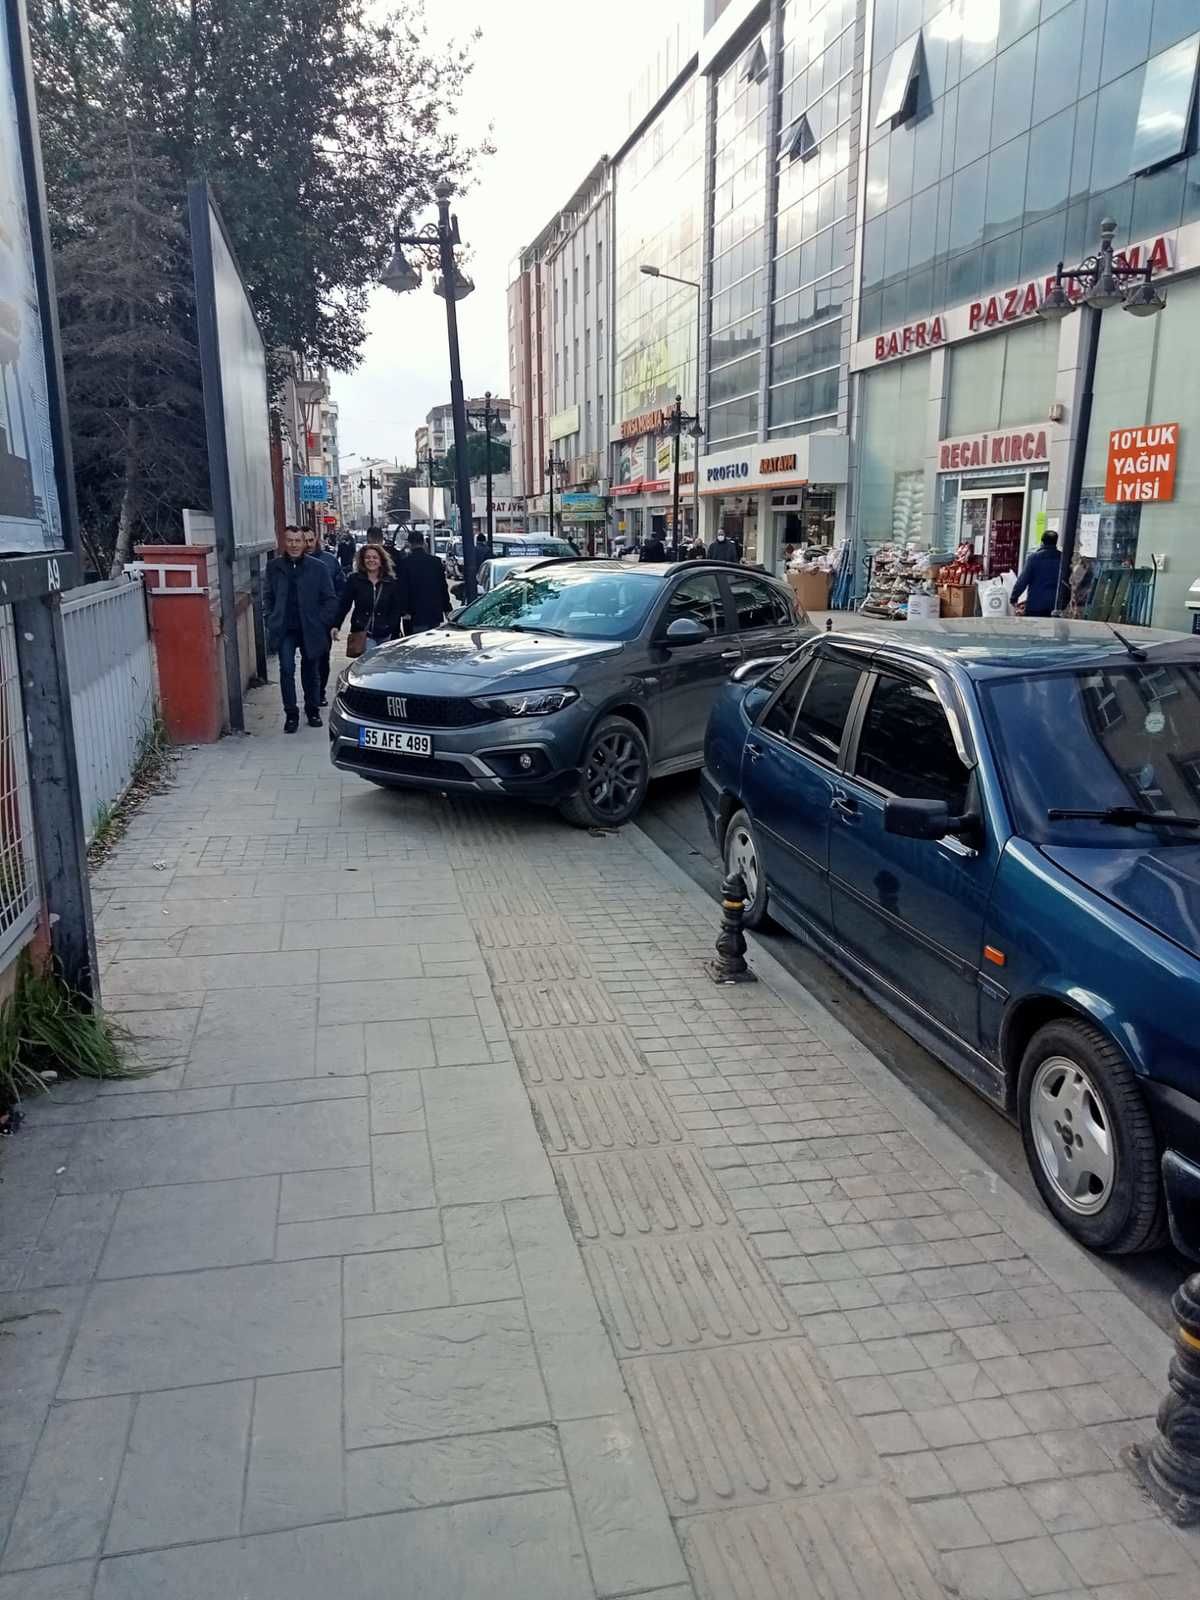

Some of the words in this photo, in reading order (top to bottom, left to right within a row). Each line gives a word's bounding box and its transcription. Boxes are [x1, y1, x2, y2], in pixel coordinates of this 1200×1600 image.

[875, 316, 944, 361] BAFRA
[1111, 425, 1176, 450] 10'LUK
[940, 434, 988, 470] RECAİ
[991, 431, 1047, 464] KIRCA
[1113, 452, 1170, 476] YAĞIN
[1116, 477, 1160, 501] İYİSİ
[47, 558, 60, 592] A9
[386, 696, 407, 719] FIAT
[365, 729, 378, 745] 55
[382, 732, 402, 749] AFE
[406, 735, 428, 752] 489
